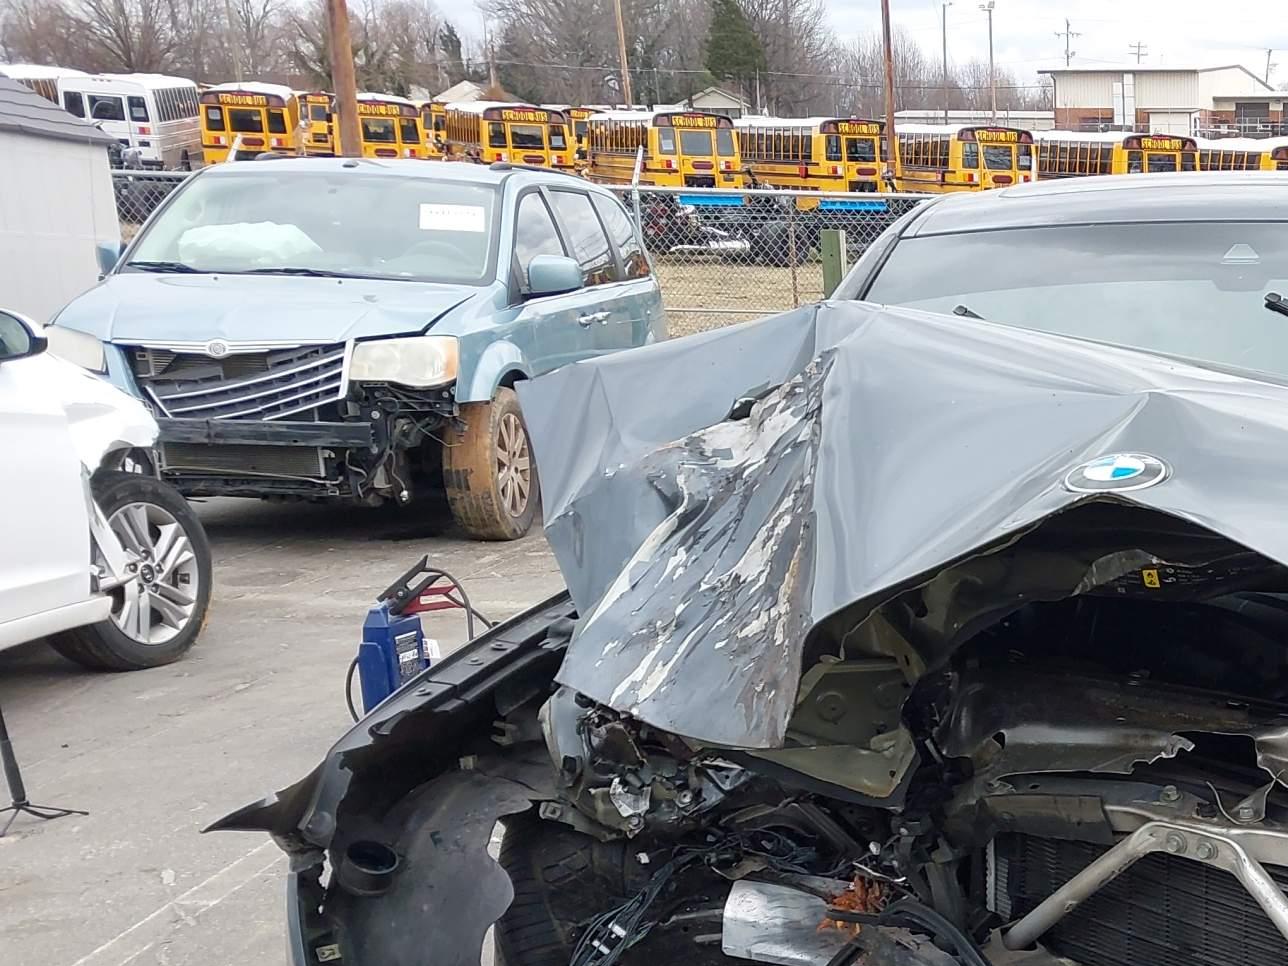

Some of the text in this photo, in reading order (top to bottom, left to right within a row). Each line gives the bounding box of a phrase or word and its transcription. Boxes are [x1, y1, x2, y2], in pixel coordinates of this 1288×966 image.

[502, 110, 548, 122] SCHOOL BUS
[672, 116, 716, 128] SCHOOL BUS
[839, 122, 880, 134] SCHOOL BUS
[978, 131, 1016, 142] SCHOOL BUS
[1142, 138, 1182, 150] SCHOOL BUS
